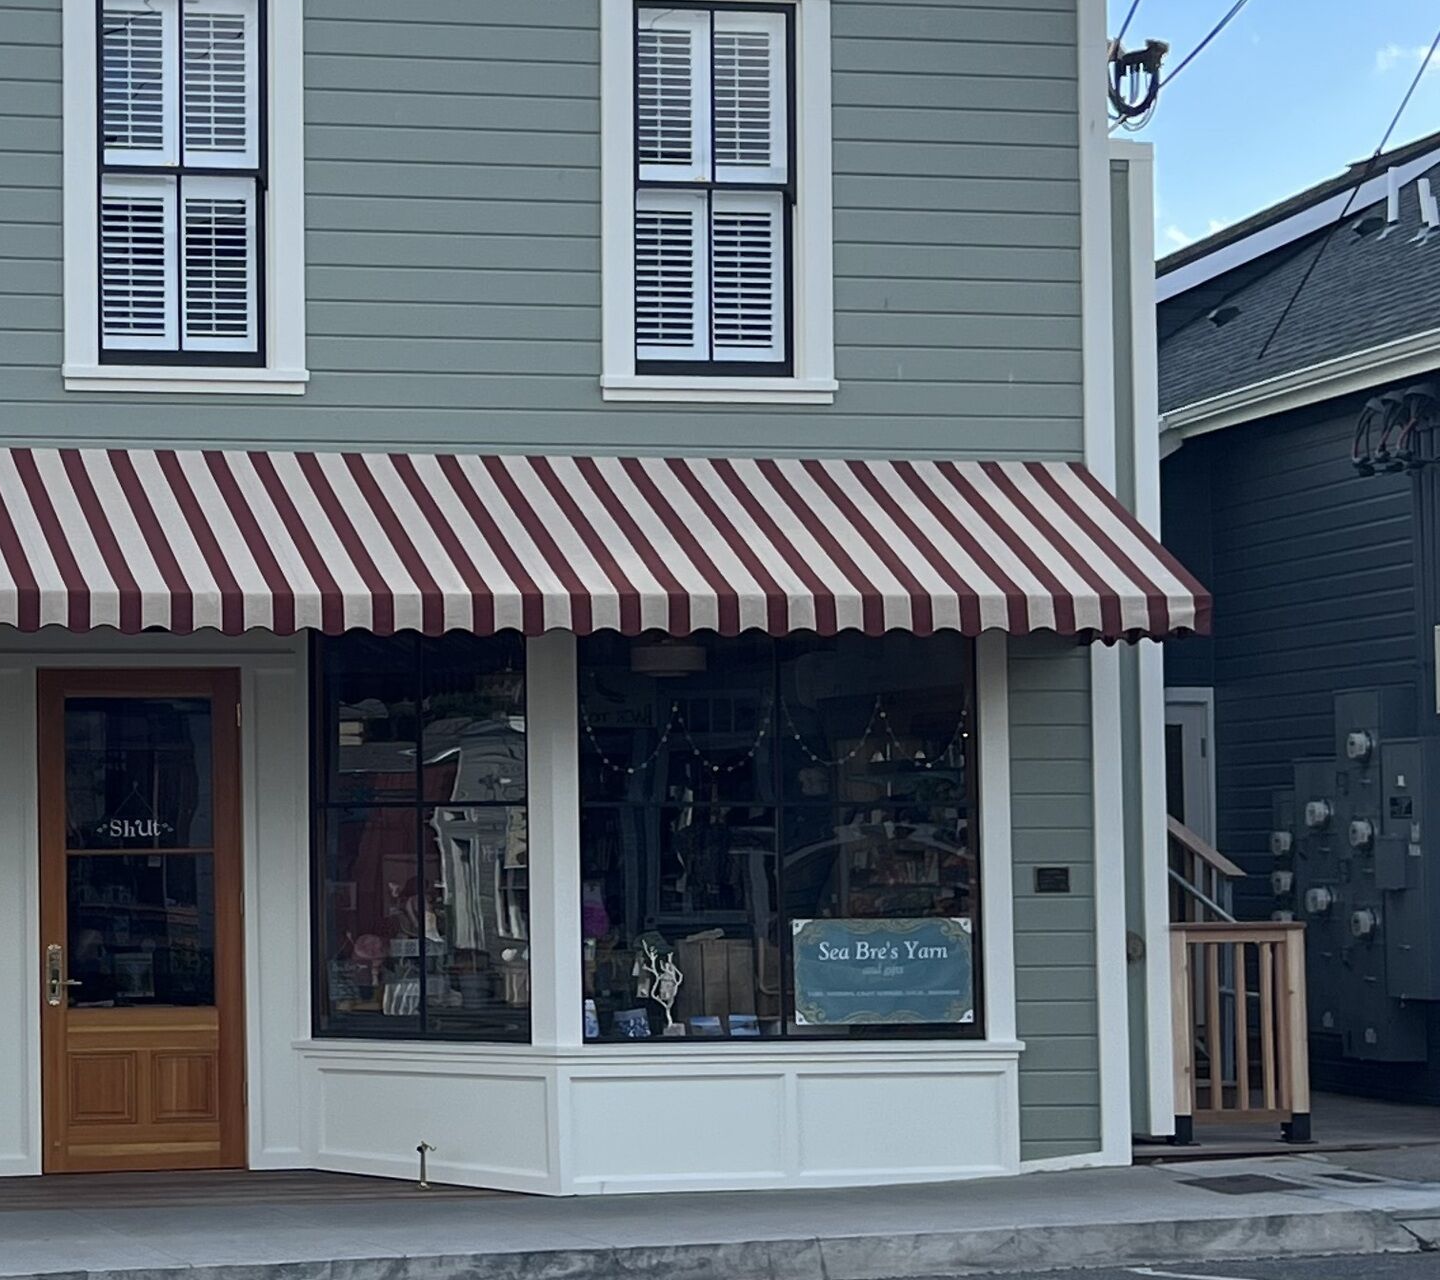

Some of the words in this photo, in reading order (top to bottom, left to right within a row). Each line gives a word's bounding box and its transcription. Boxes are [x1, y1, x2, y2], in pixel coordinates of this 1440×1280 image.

[818, 941, 849, 961] Sea
[855, 940, 899, 961] Bre's
[903, 939, 948, 960] Yarn
